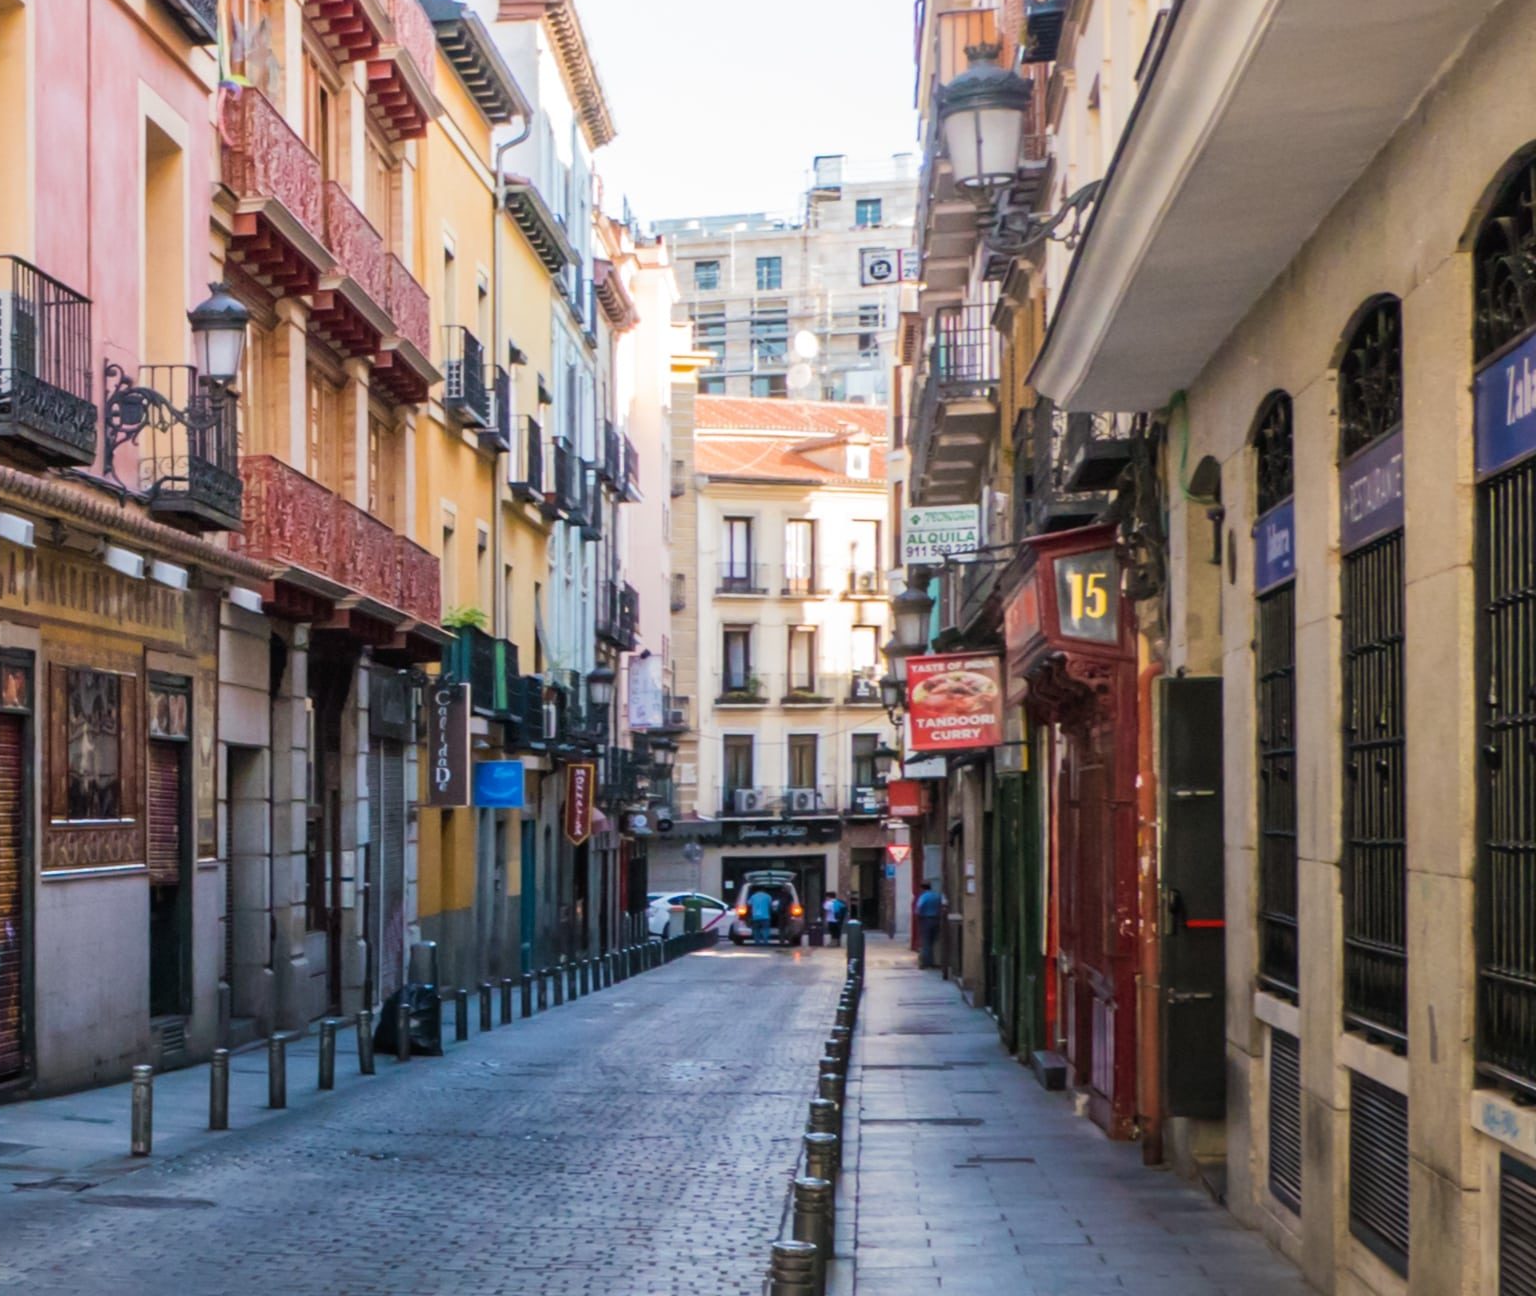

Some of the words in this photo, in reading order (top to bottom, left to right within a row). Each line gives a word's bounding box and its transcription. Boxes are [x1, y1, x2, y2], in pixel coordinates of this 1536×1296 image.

[908, 530, 975, 545] ALQUILA
[907, 546, 927, 558] 911
[1066, 569, 1108, 622] 15
[916, 714, 994, 728] TANDOORI
[931, 728, 981, 741] CURRY
